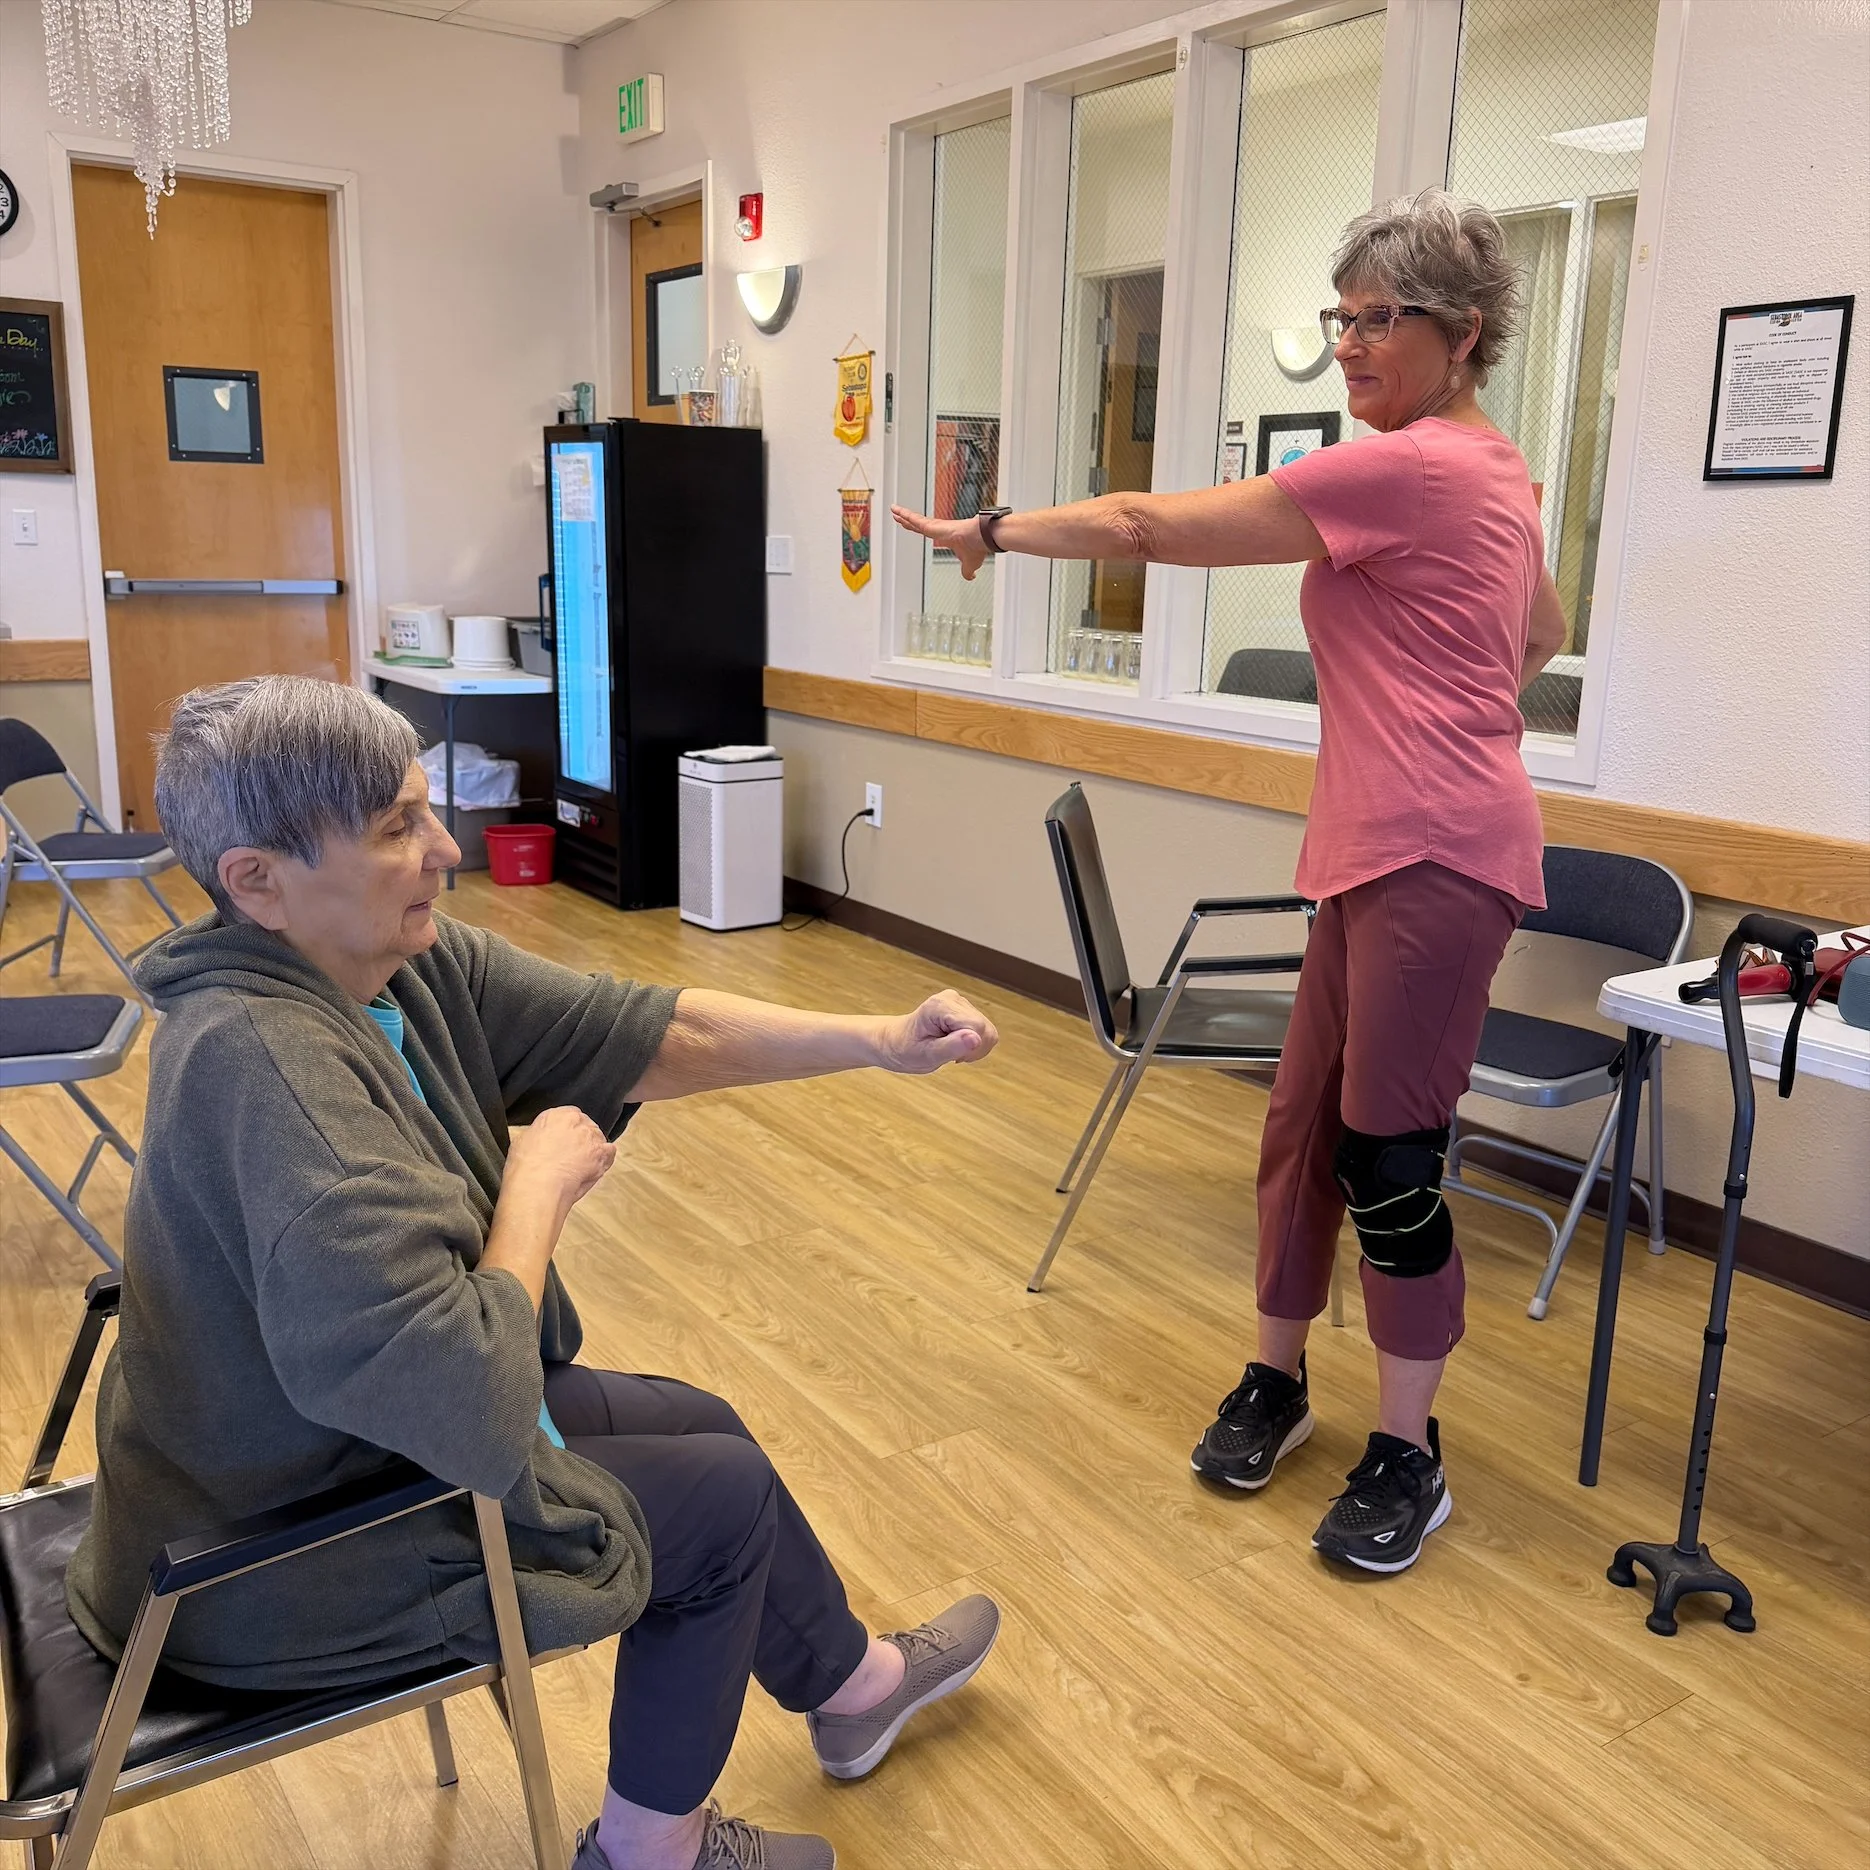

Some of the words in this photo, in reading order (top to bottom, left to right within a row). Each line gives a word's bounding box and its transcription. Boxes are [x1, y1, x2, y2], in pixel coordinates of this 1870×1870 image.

[618, 78, 644, 133] EXIT
[0, 197, 9, 207] 3
[7, 328, 37, 355] Day
